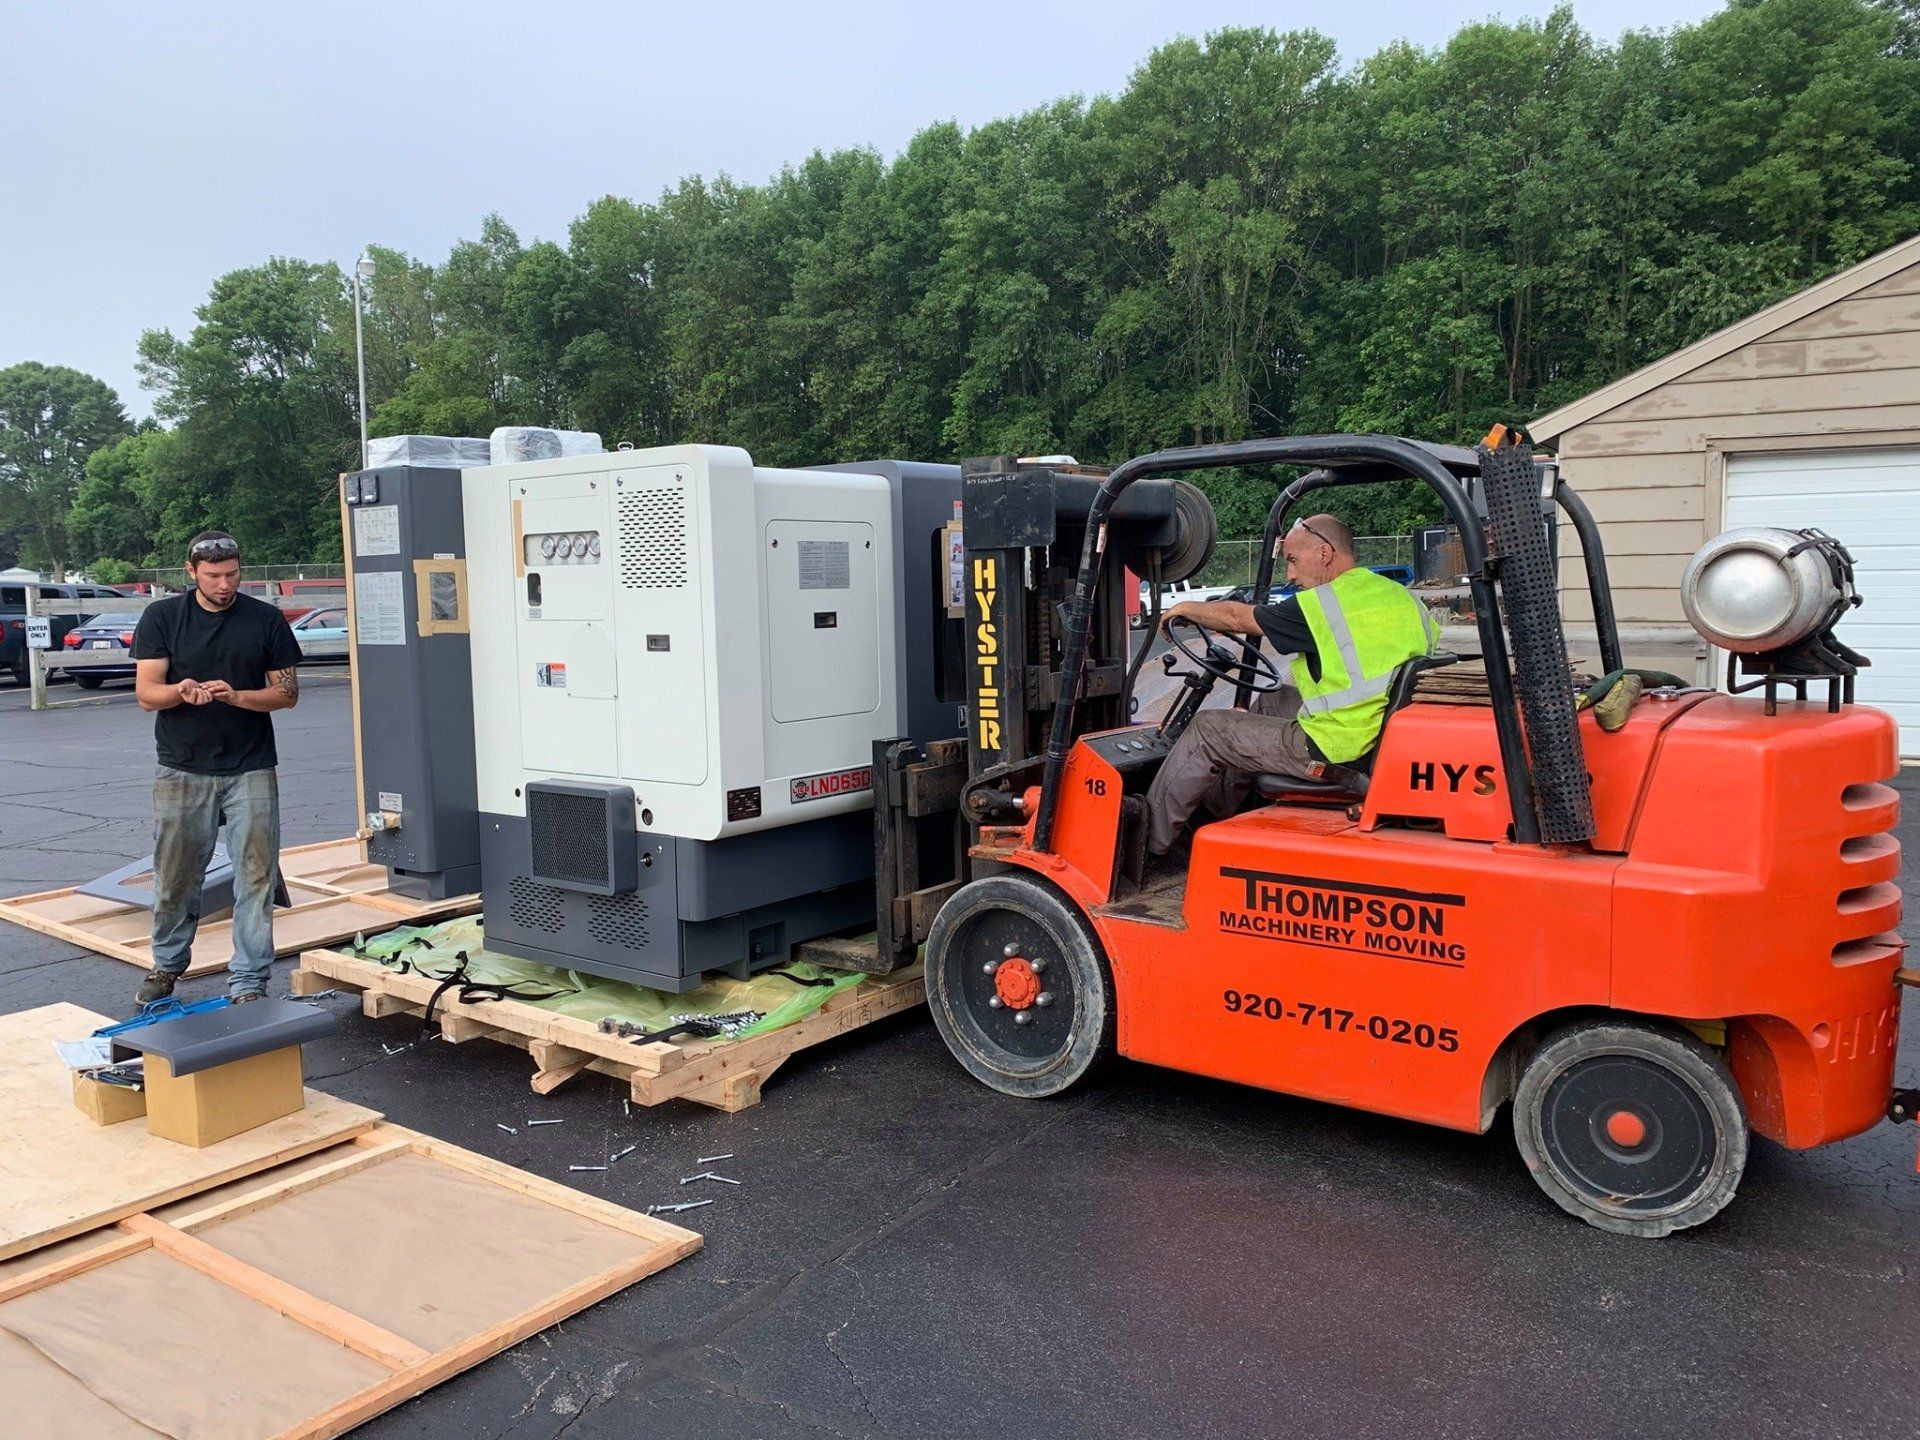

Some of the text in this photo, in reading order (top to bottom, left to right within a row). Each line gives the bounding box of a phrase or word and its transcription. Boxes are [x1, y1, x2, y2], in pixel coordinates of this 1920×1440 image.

[30, 631, 46, 639] ONLY
[974, 558, 1002, 751] HYSTER
[1084, 778, 1107, 797] 18
[1409, 761, 1496, 796] HYS
[1219, 866, 1466, 937] THOMPSON
[1219, 910, 1467, 962] MACHINERY MOVING
[1222, 988, 1460, 1053] 920-717-0205
